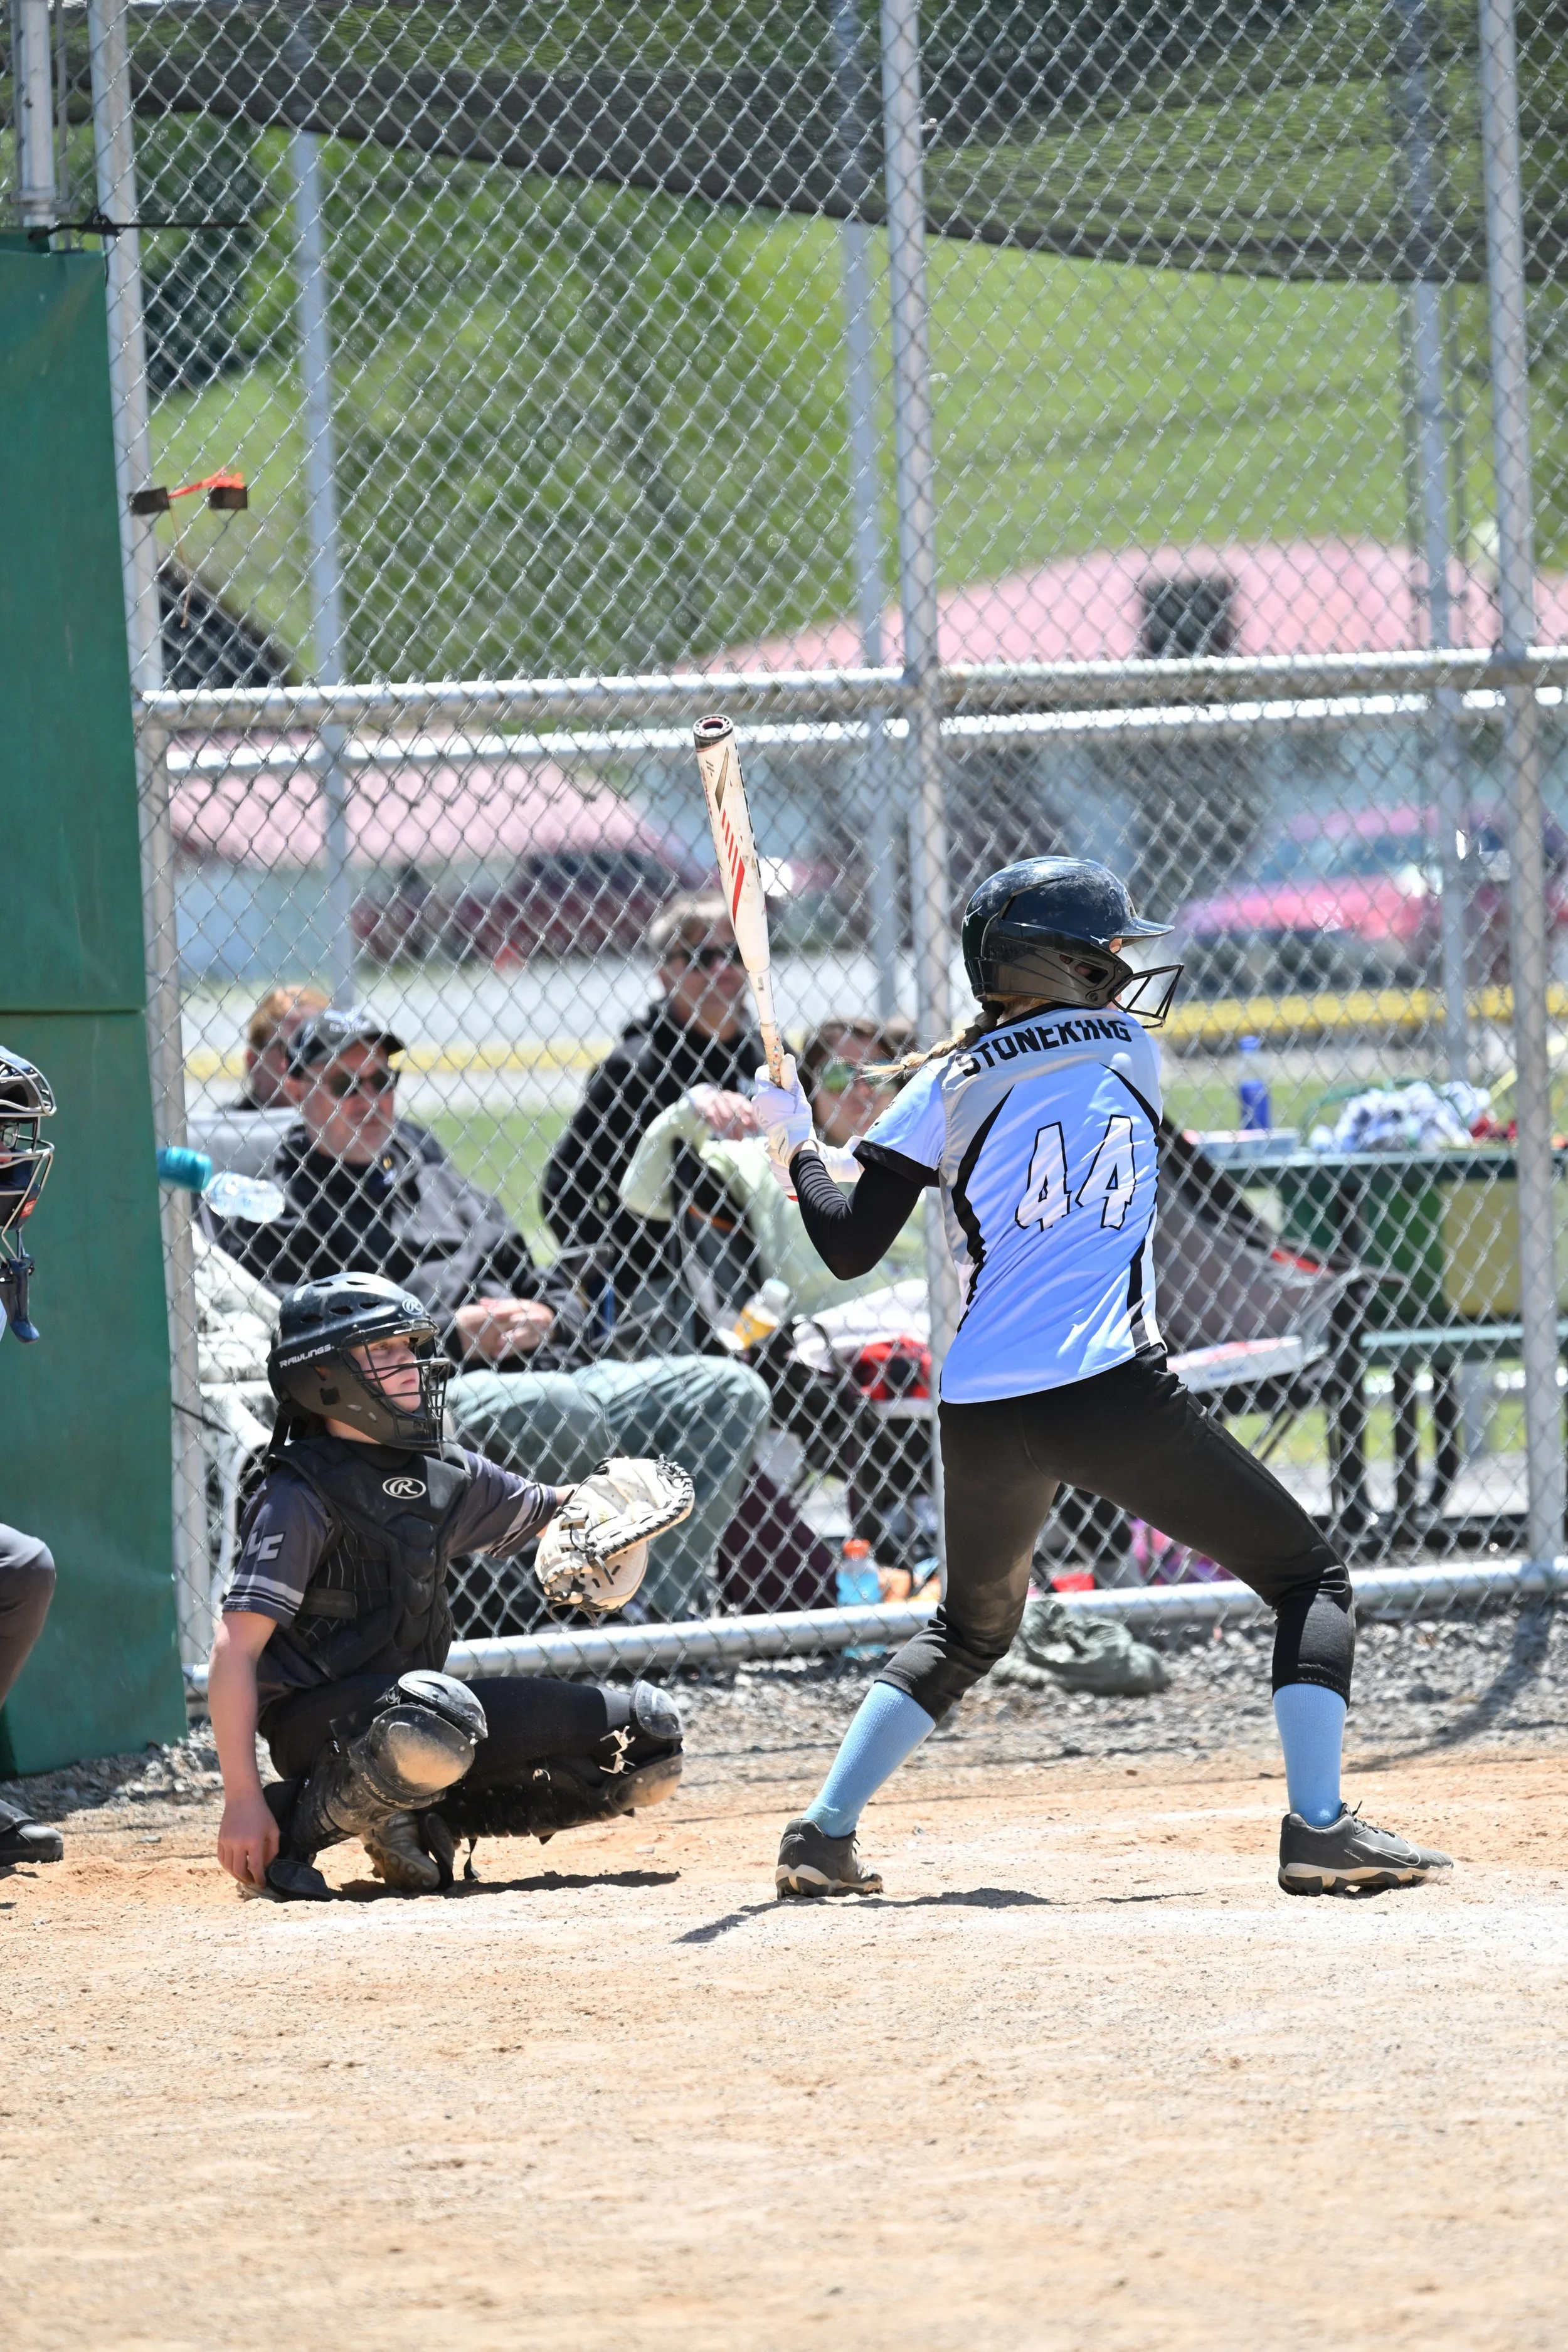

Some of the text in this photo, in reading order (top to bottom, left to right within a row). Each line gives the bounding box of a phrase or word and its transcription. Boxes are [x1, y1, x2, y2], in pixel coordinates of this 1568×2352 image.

[955, 1019, 1132, 1077] STONEKING
[1014, 1113, 1136, 1232] 44
[278, 1343, 332, 1369] RAWLINGS
